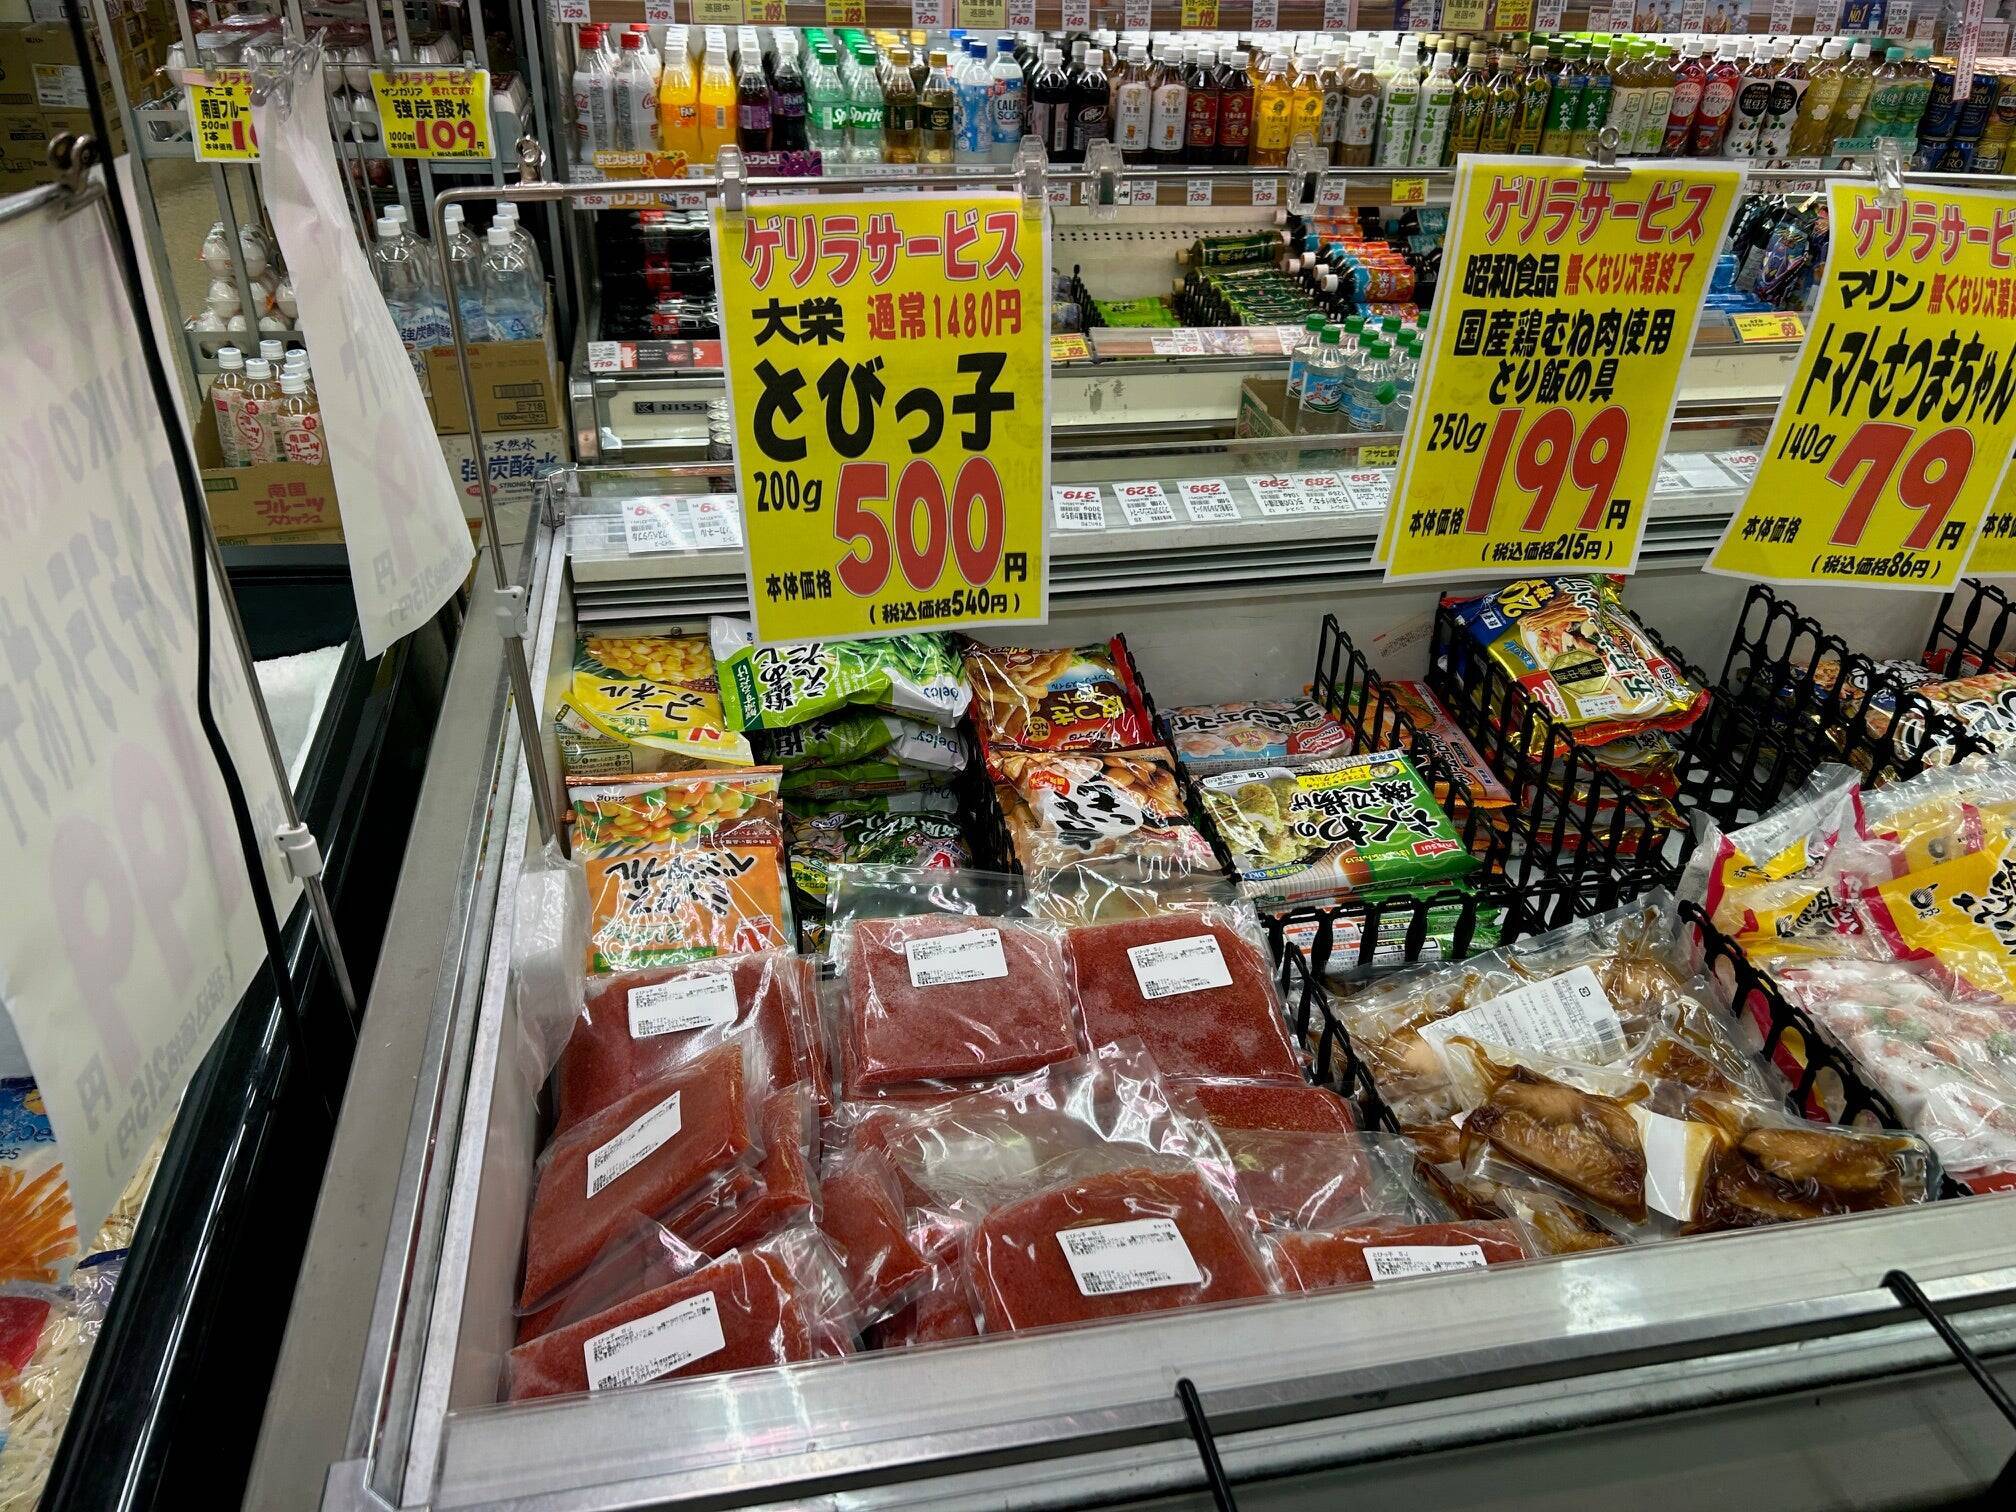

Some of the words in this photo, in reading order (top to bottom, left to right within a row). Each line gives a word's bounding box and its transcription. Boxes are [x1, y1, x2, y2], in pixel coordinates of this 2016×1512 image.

[394, 99, 472, 119] 強炭酸水
[414, 119, 476, 150] 109
[1484, 175, 1717, 246] ゲリラサービス
[741, 209, 1024, 291] ゲリラサービス
[1462, 253, 1560, 299] 昭和食品
[1564, 252, 1695, 297] 無くなり次第終了
[1838, 268, 1926, 313] マリン
[752, 298, 845, 346] 大栄
[866, 288, 1022, 341] 通常1480円
[1453, 307, 1676, 358] 国産鶏むね肉使用
[1488, 358, 1619, 405] とり飯の具
[527, 402, 544, 411] 718
[752, 352, 1015, 462] とびっ子
[494, 436, 537, 453] 天然水
[1427, 412, 1487, 453] 250g
[1777, 423, 1837, 464] 140g
[267, 481, 308, 499] 南国
[1465, 405, 1631, 536] 199
[1604, 500, 1630, 530] 円
[1825, 421, 1976, 552] 79
[1936, 521, 1967, 550] 円
[253, 496, 326, 516] フルーツ
[753, 470, 823, 513] 200g
[834, 456, 1005, 597] 500
[1003, 552, 1027, 583] 円
[1408, 509, 1465, 538] 本体価格
[1741, 515, 1803, 544] 本体価格
[1981, 512, 2016, 539] 本体
[765, 569, 833, 603] 本体価格
[598, 684, 706, 711] カーネル
[614, 700, 689, 723] コーン
[1173, 702, 1322, 732] エビシューマイ
[1294, 805, 1438, 848] ちくわの
